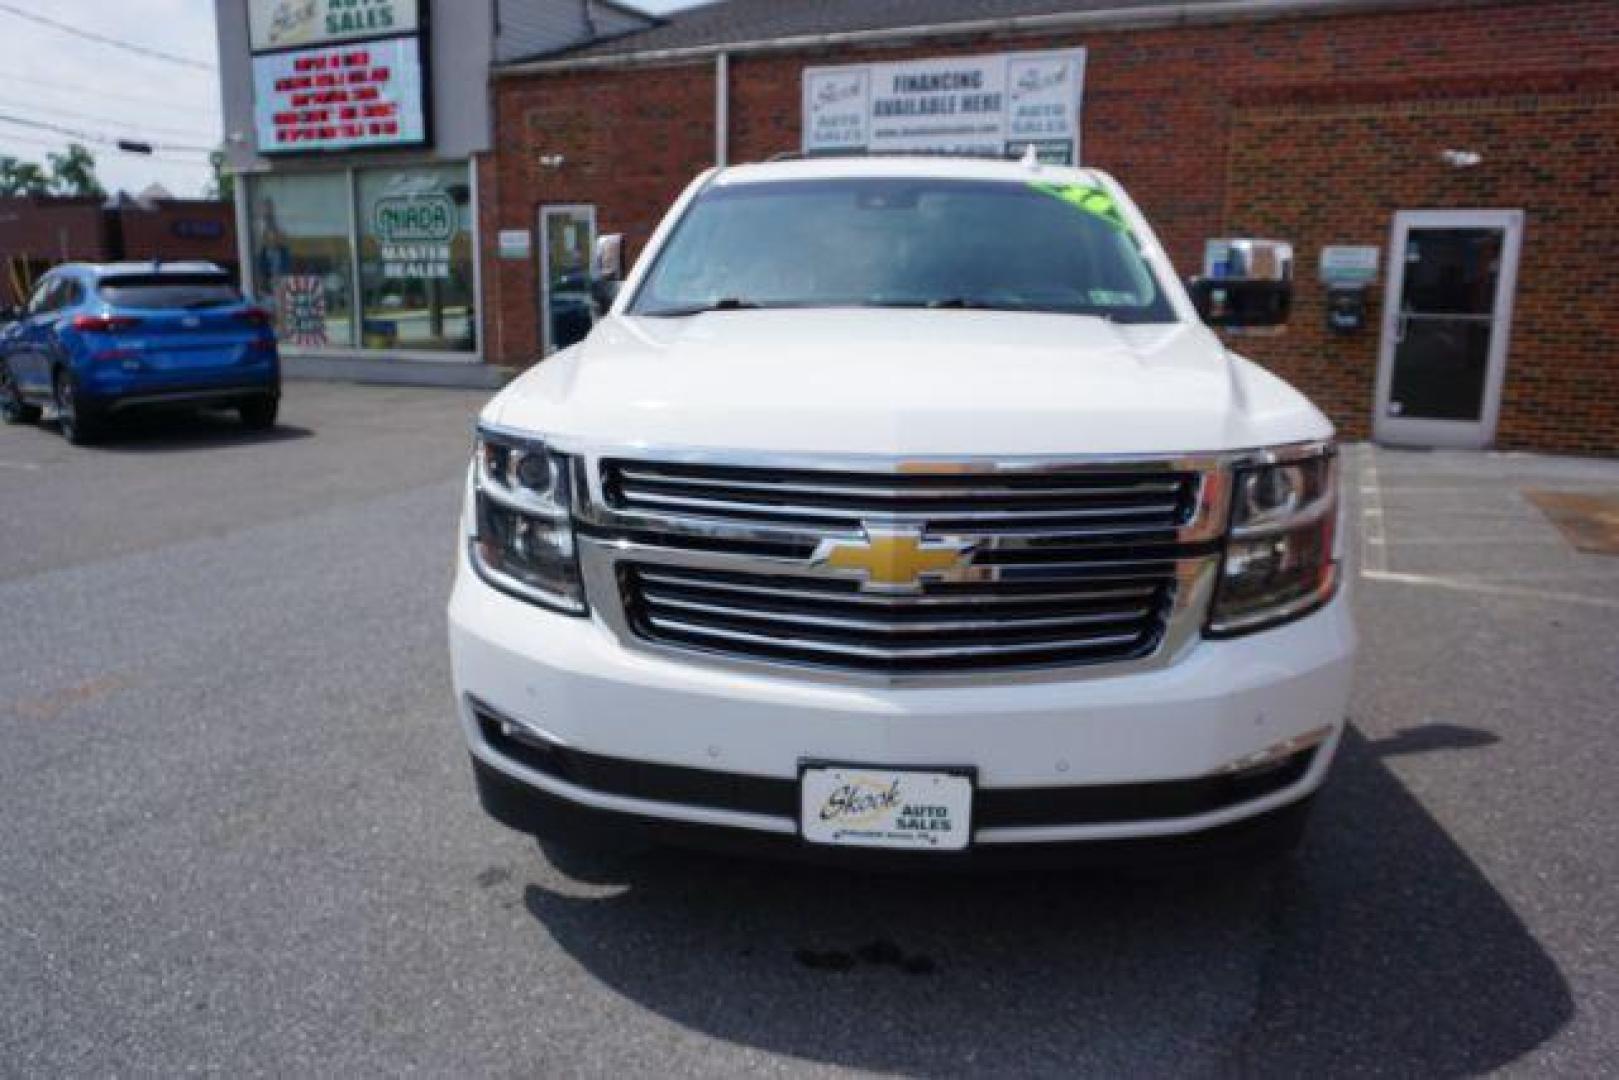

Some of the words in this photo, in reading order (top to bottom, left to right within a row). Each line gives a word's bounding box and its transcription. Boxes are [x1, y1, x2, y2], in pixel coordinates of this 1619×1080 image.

[325, 6, 393, 34] SALES
[892, 70, 983, 93] FINANCING
[874, 95, 956, 117] AVAILABLE
[960, 92, 1002, 113] HERE
[381, 245, 449, 260] MASTER
[902, 804, 948, 818] AUTO
[895, 817, 952, 833] SALES
